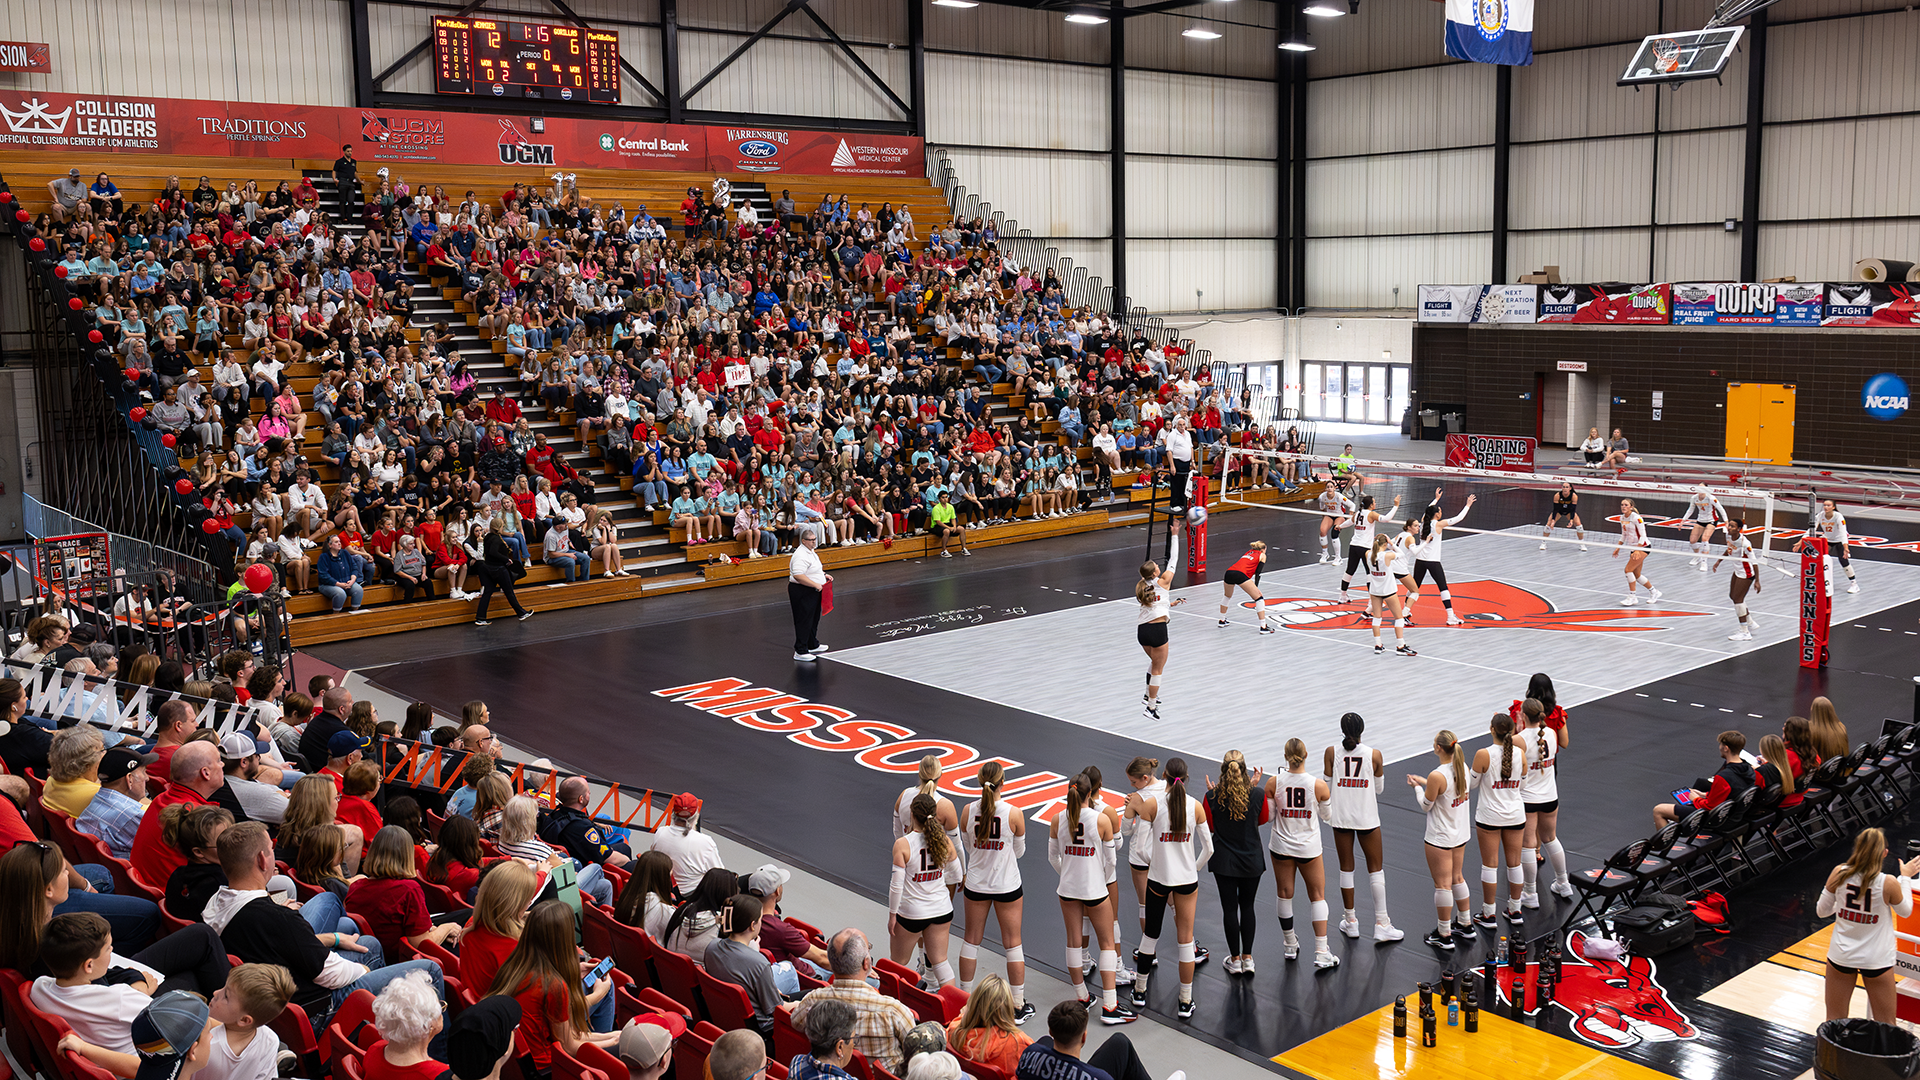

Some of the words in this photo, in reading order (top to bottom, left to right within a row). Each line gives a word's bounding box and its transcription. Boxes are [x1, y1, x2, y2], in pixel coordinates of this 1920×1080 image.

[474, 21, 496, 30] JENNIES
[554, 28, 578, 36] GORILLAS
[488, 32, 500, 48] 12
[524, 25, 548, 42] 1:15
[570, 39, 579, 54] 6
[543, 49, 550, 61] 0
[487, 68, 494, 80] 0
[502, 70, 509, 81] 2
[534, 72, 537, 83] 1
[558, 74, 561, 84] 1
[575, 75, 582, 86] 0
[75, 100, 156, 118] COLLISION
[76, 117, 157, 137] LEADERS
[197, 117, 306, 139] TRADITIONS
[389, 117, 444, 134] UCM
[0, 134, 30, 144] OFFICIAL
[32, 135, 69, 145] COLLISION
[70, 137, 96, 146] CENTER
[98, 138, 106, 147] OF
[108, 139, 123, 147] UCM
[124, 140, 158, 149] ATHLETICS
[390, 132, 444, 145] STORE
[618, 137, 657, 150] Central
[660, 139, 689, 152] Bank
[726, 129, 789, 145] WARRENSBURG
[499, 144, 556, 165] UCM
[746, 142, 771, 156] Ford
[850, 145, 879, 155] WESTERN
[880, 147, 909, 156] MISSOURI
[1864, 395, 1909, 410] NCAA
[1468, 435, 1527, 455] ROARING
[1475, 452, 1503, 470] RED
[1803, 563, 1817, 661] JENNIES
[1343, 757, 1362, 778] 17
[1337, 778, 1369, 788] JENNIES
[1286, 787, 1305, 808] 18
[1280, 809, 1311, 819] JENNIES
[1072, 822, 1084, 845] 2
[1065, 846, 1096, 856] JENNIES
[912, 870, 942, 882] JENNIES
[1846, 883, 1872, 913] 21
[1838, 908, 1880, 925] JENNIES
